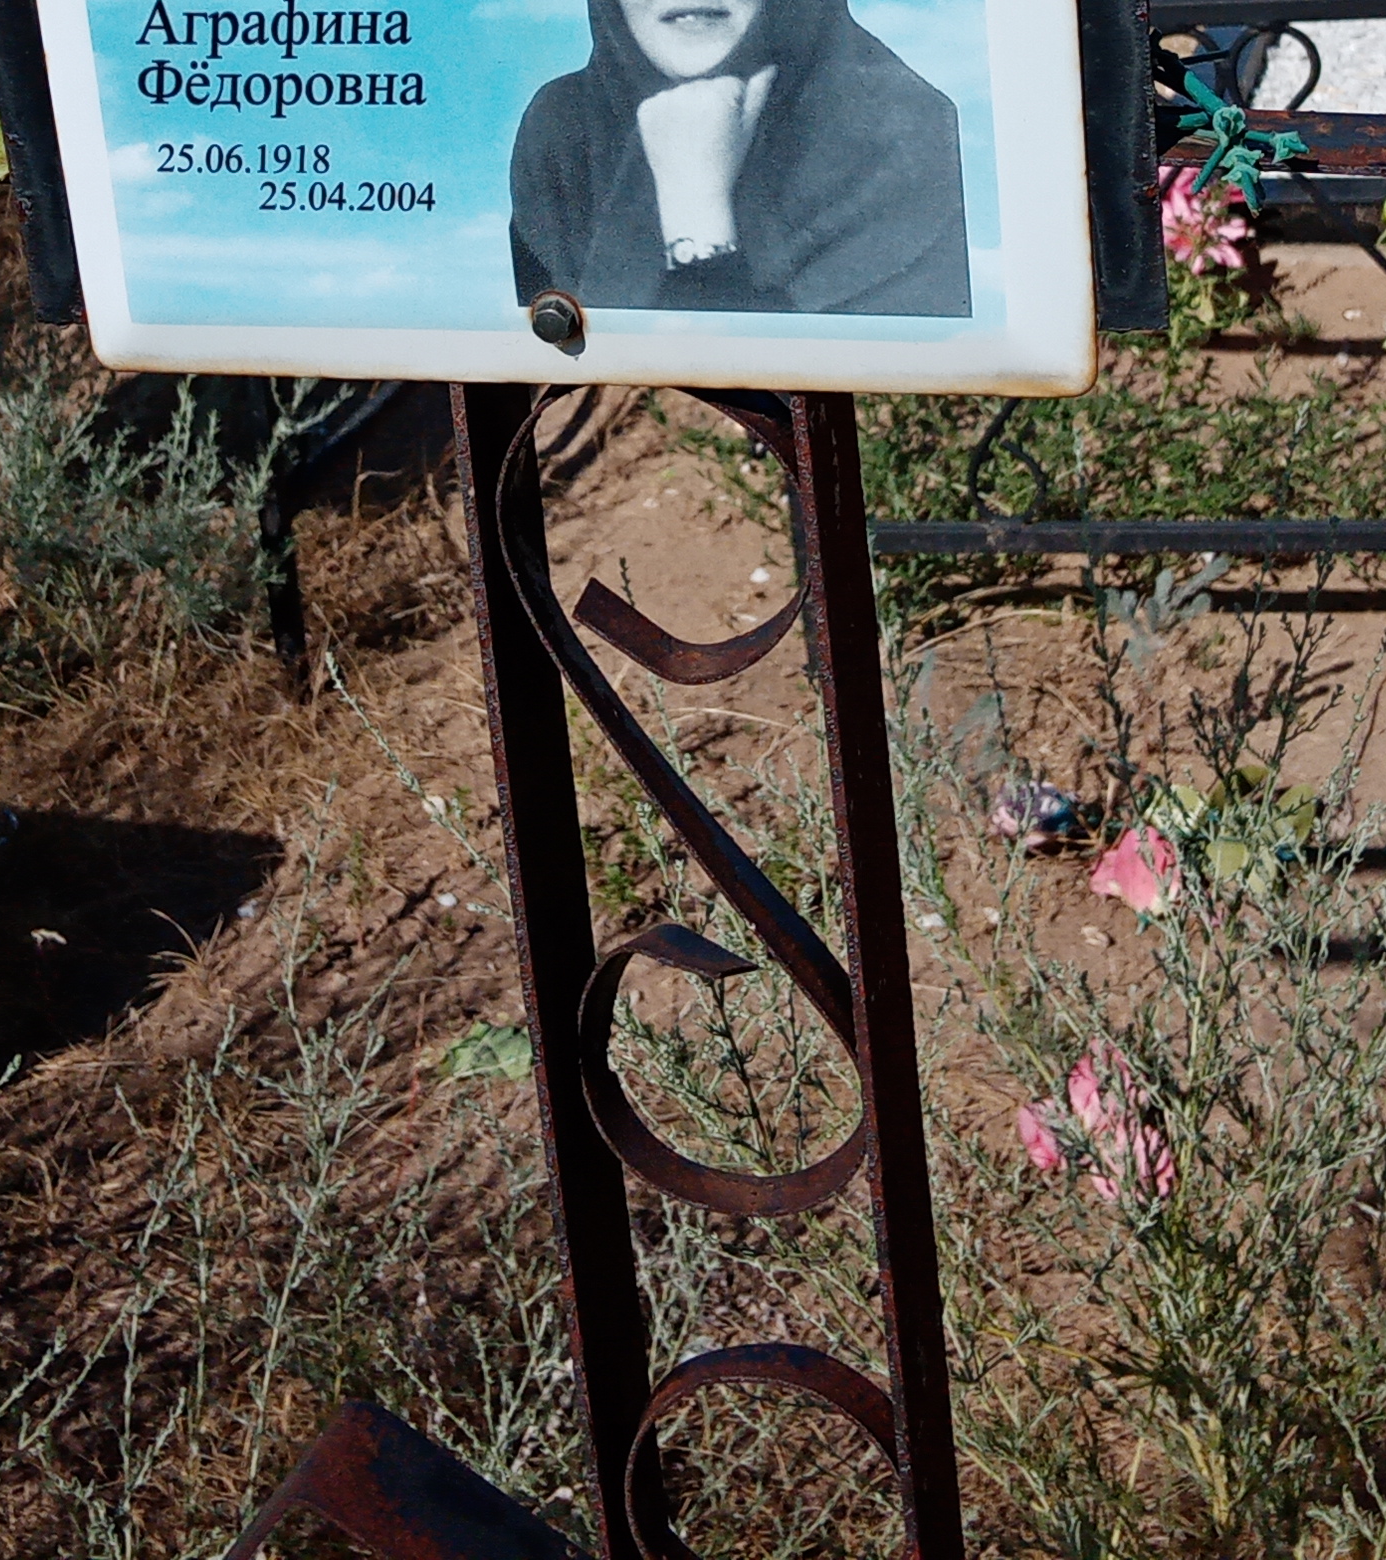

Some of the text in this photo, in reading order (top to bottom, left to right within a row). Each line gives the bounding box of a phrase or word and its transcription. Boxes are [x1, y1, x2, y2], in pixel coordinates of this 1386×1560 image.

[137, 59, 427, 118] Фёдоровна
[156, 143, 331, 174] 25.06.1918
[258, 181, 436, 212] 25.04.2004
